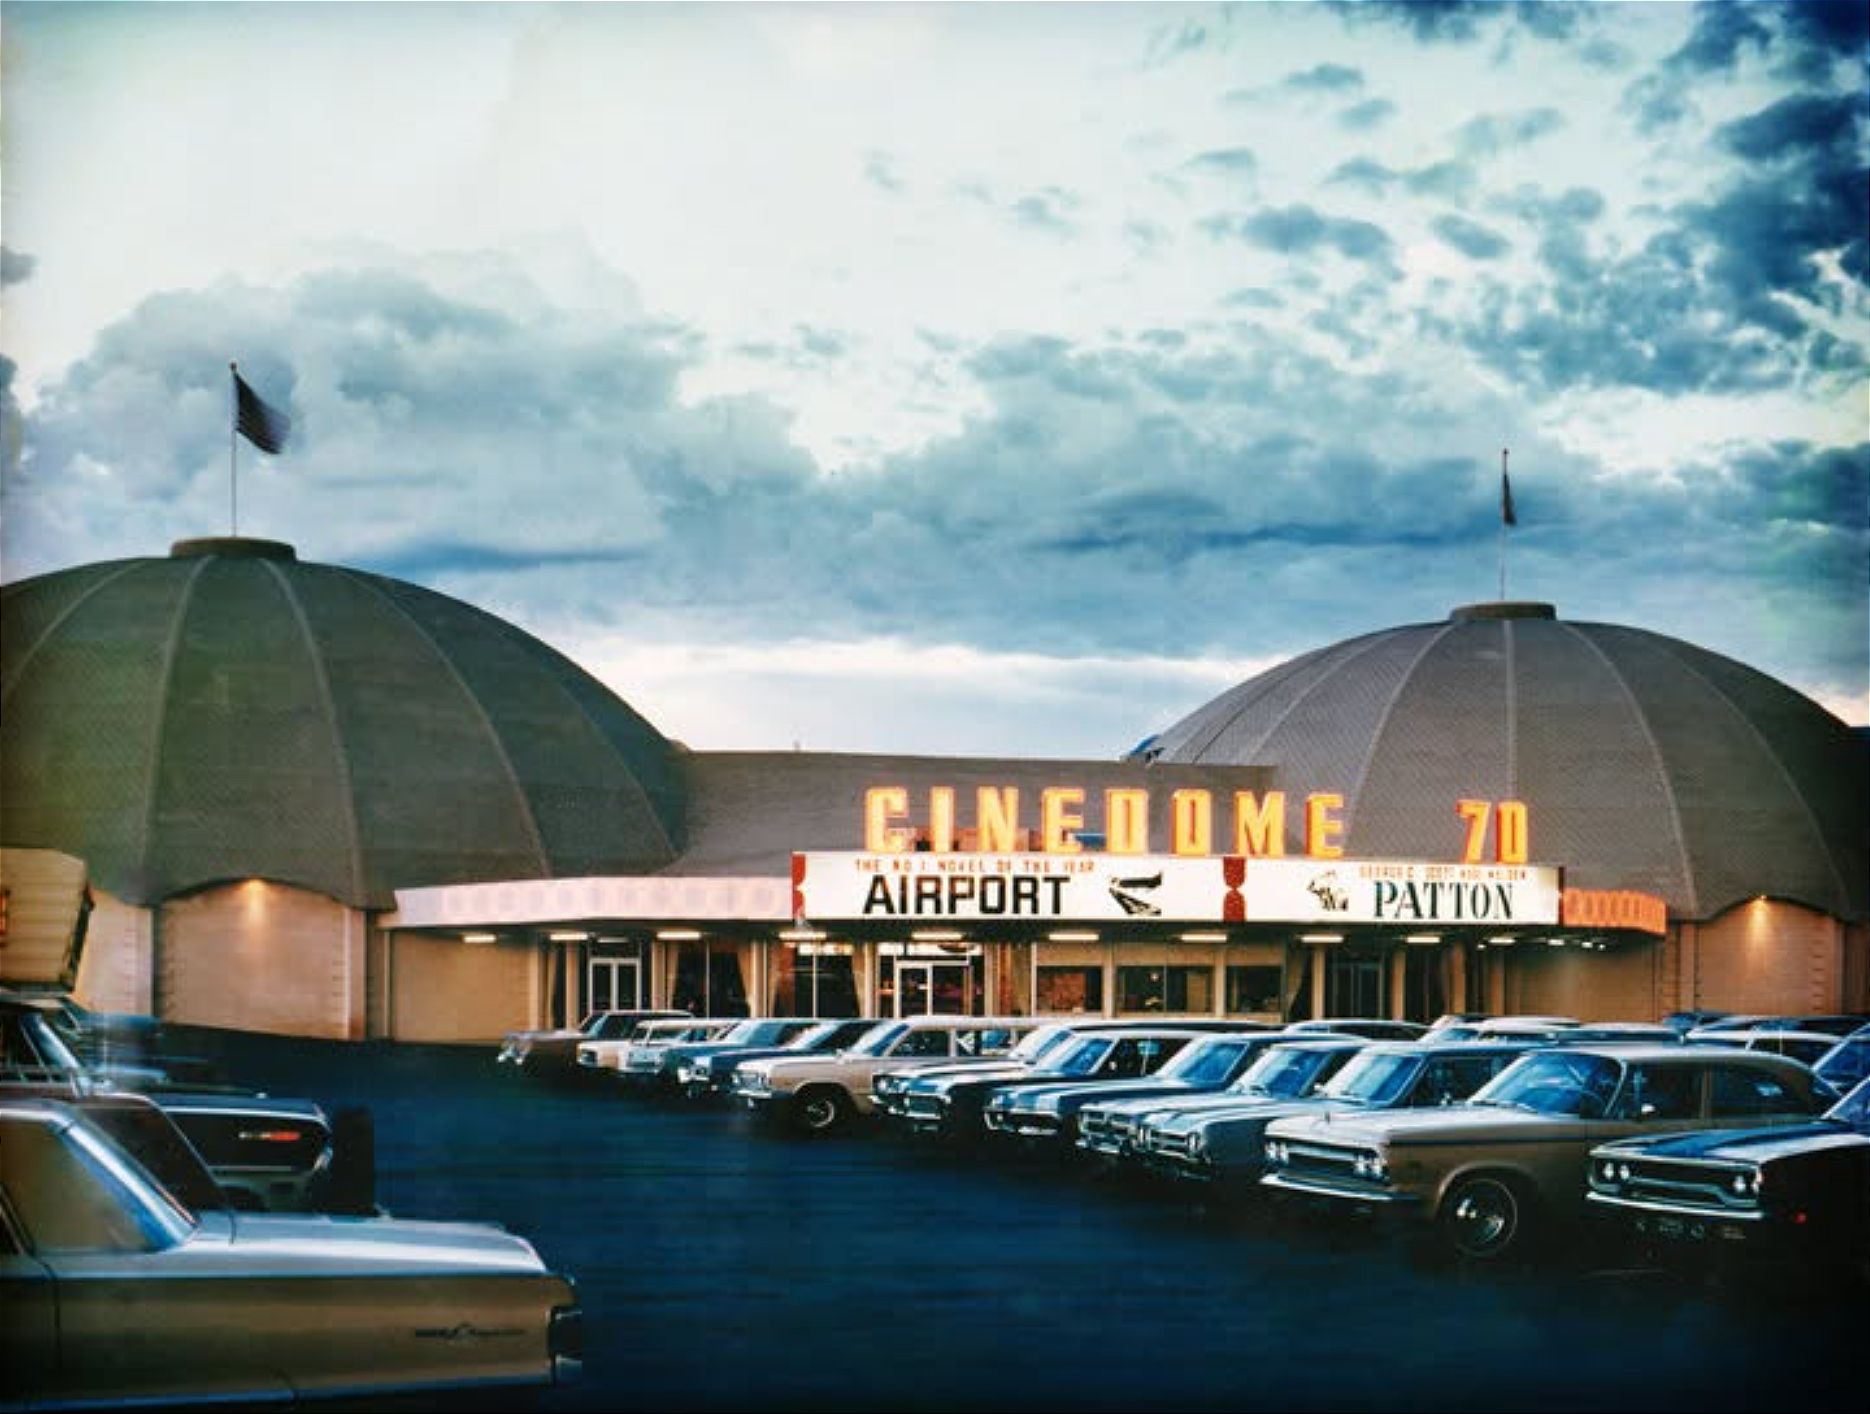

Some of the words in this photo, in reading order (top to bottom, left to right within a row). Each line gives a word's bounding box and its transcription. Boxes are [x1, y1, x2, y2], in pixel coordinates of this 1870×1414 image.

[864, 785, 1345, 858] CINEDOME
[1454, 799, 1528, 864] 70
[855, 858, 880, 872] THE
[937, 859, 985, 873] NOVEL
[1023, 859, 1052, 873] THE
[863, 873, 1071, 915] AIRPORT
[1373, 880, 1514, 920] PATTON
